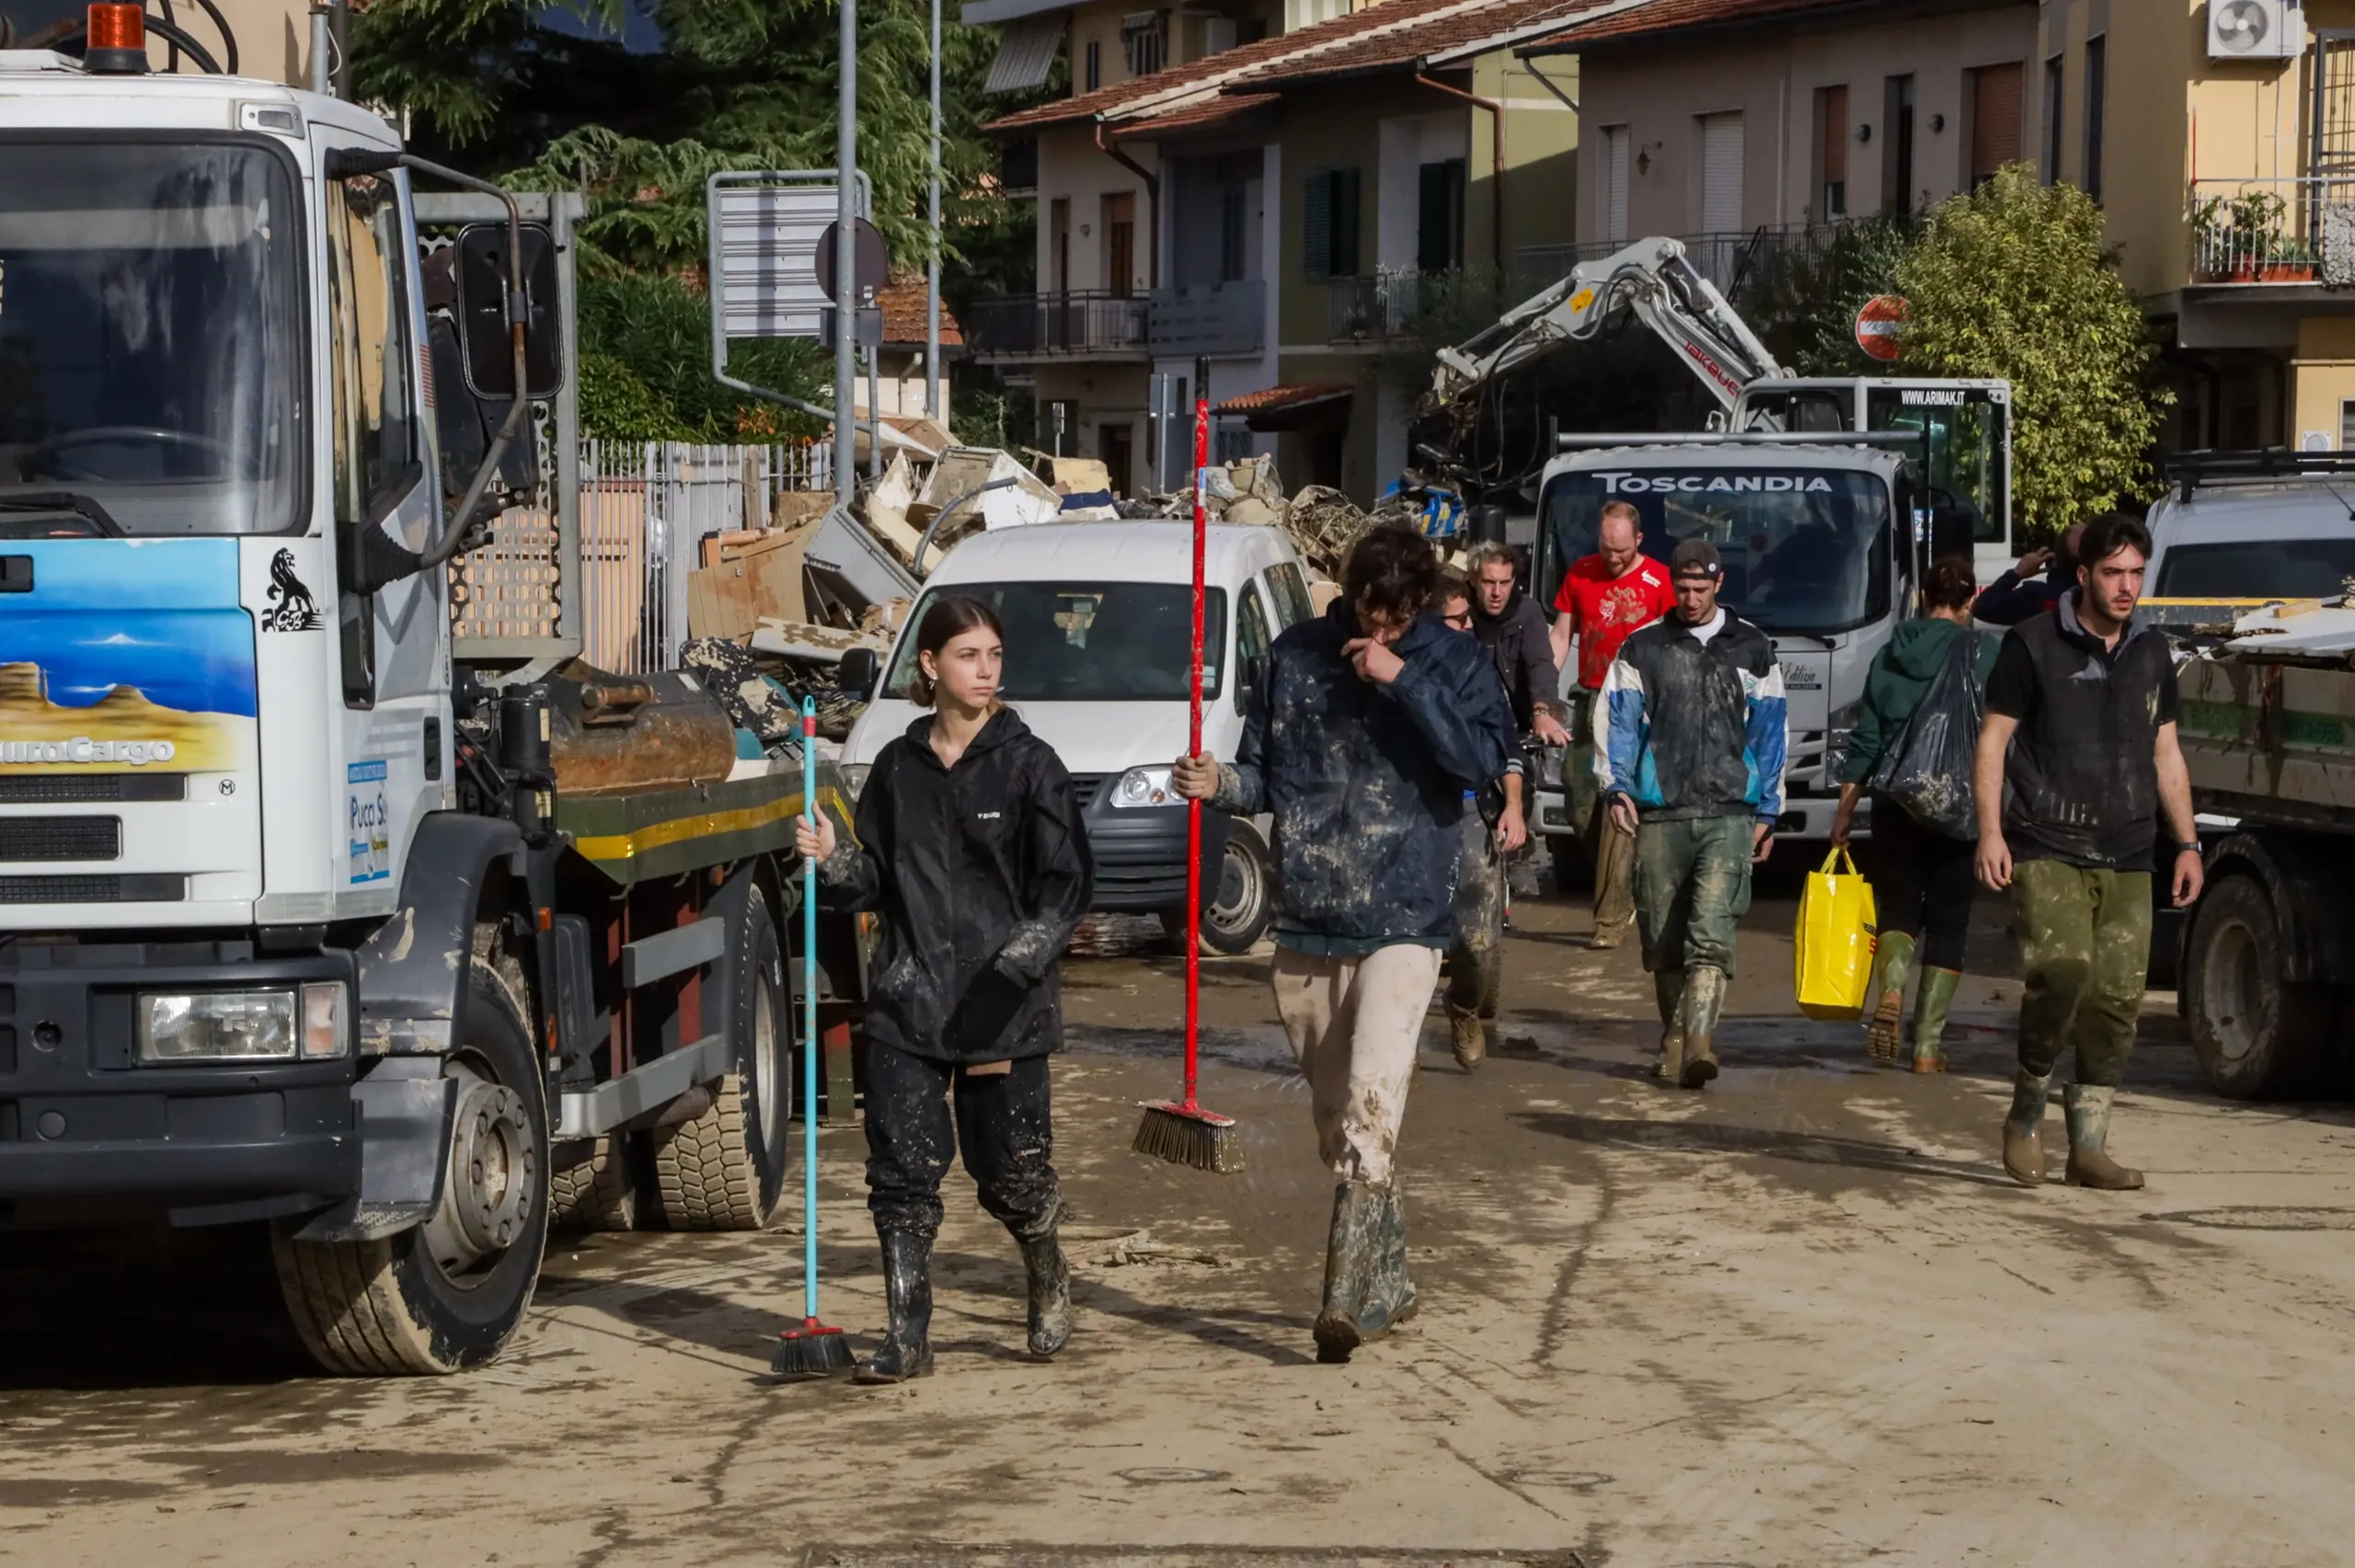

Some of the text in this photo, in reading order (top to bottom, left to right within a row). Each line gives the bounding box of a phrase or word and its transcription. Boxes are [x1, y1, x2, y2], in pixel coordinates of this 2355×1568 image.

[1901, 390, 1966, 406] WWW.ARIMAK.IT
[1591, 472, 1833, 494] TOSCANDIA
[0, 736, 175, 766] uroCargo
